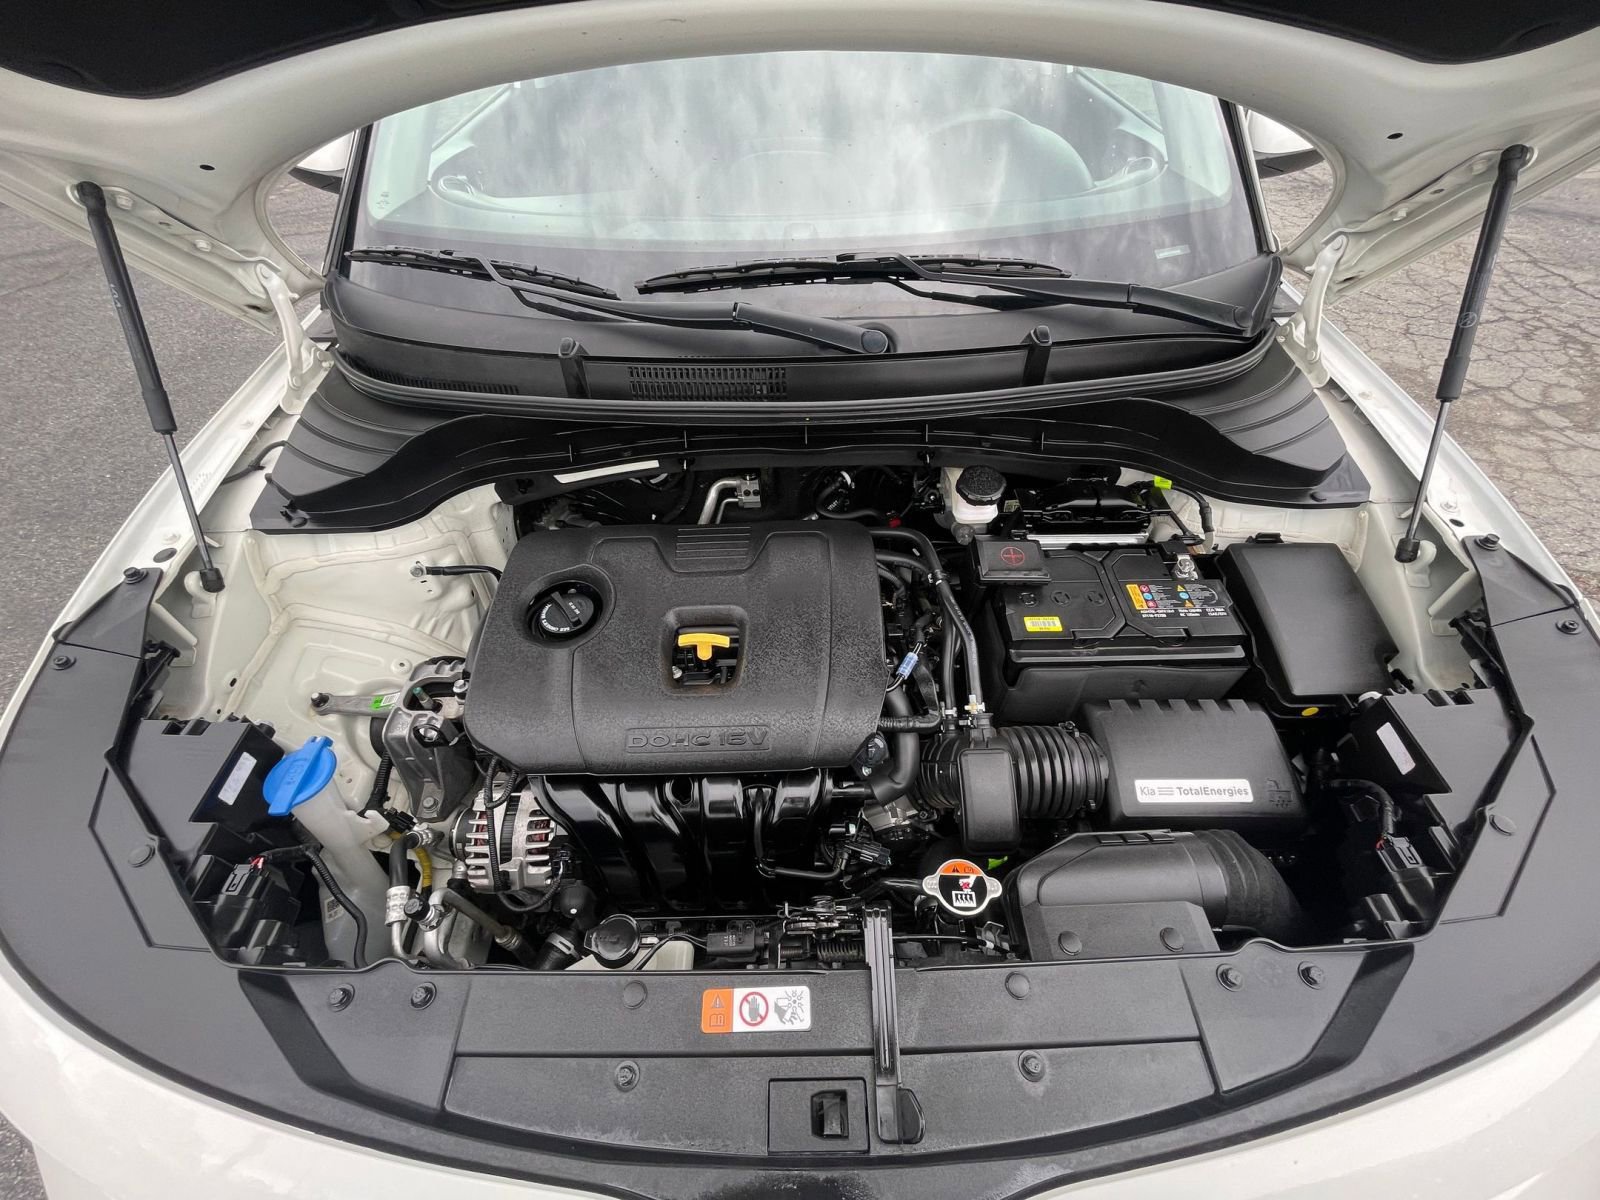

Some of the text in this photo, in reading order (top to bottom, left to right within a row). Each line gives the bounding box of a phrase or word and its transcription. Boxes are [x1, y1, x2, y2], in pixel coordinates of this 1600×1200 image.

[627, 729, 768, 748] DOHC 16V
[1140, 786, 1249, 797] Kia TotalEnergies
